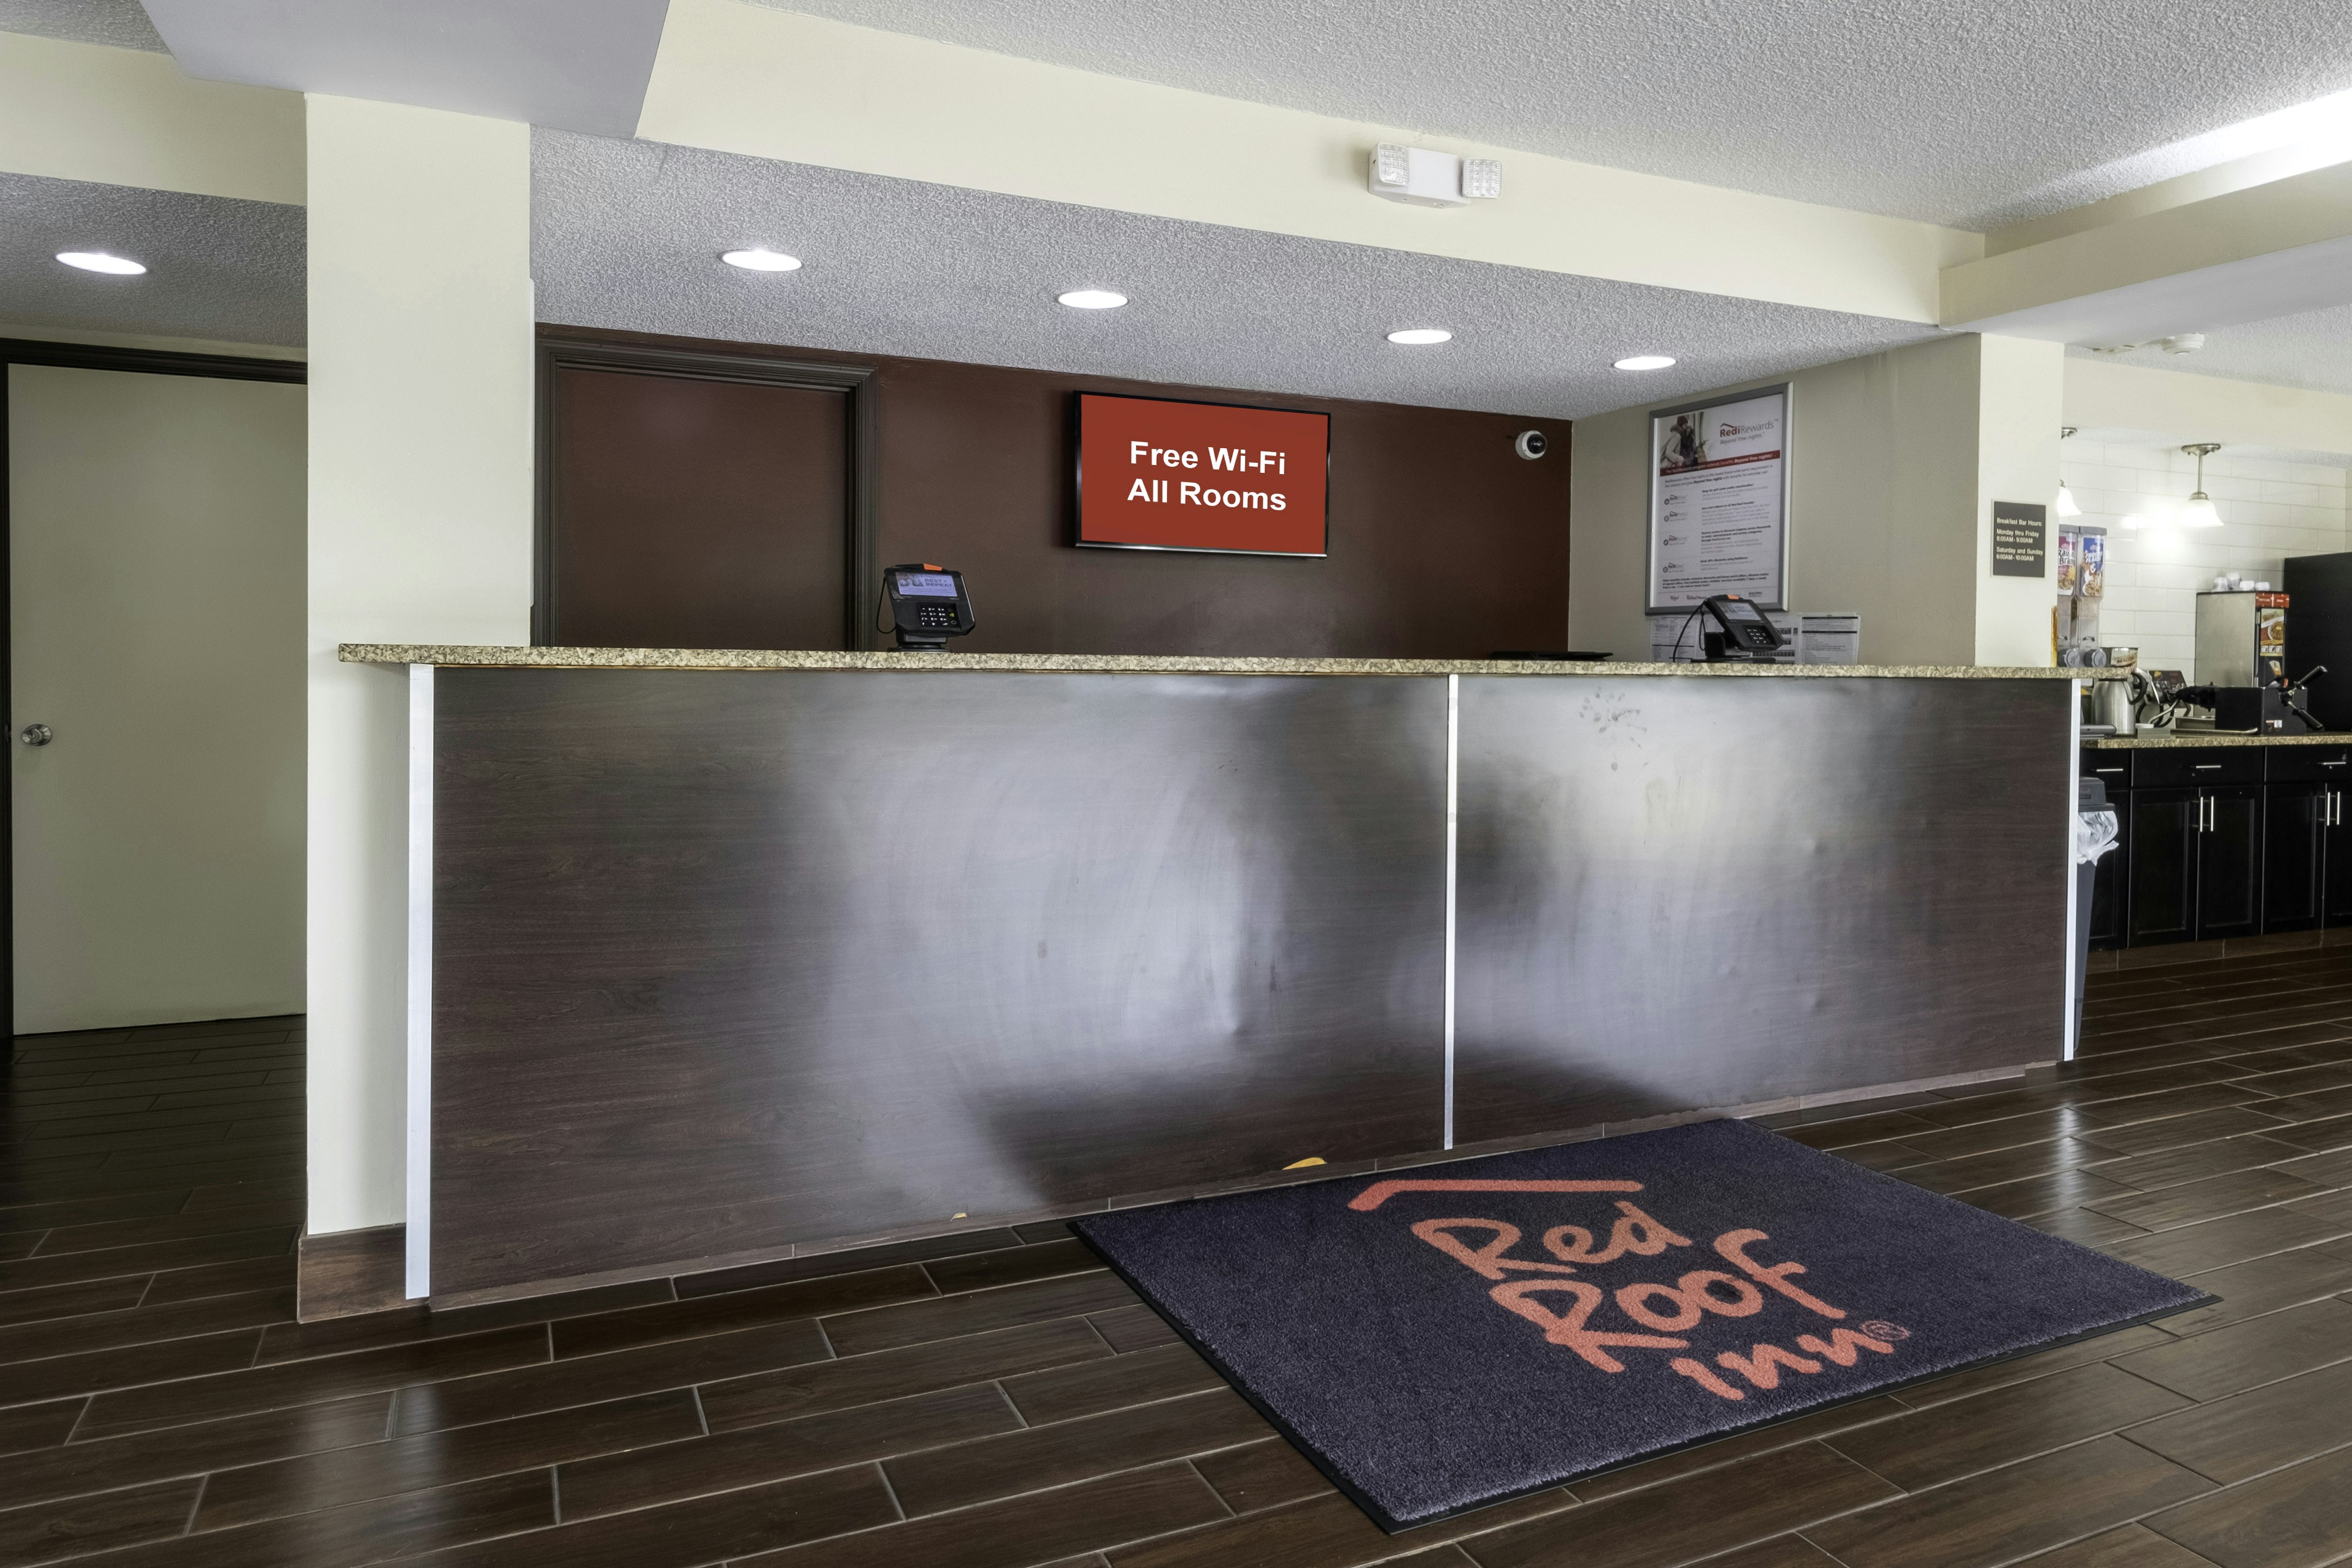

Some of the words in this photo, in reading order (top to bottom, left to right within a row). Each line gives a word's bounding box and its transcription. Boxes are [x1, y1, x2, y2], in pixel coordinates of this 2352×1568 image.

[1720, 420, 1774, 437] RediRewards
[1131, 440, 1198, 469] Free
[1207, 446, 1285, 475] Wi-Fi
[1127, 478, 1168, 503] All
[1180, 481, 1286, 510] Rooms
[1411, 1201, 1692, 1280] Red
[1489, 1229, 1847, 1374] Roof
